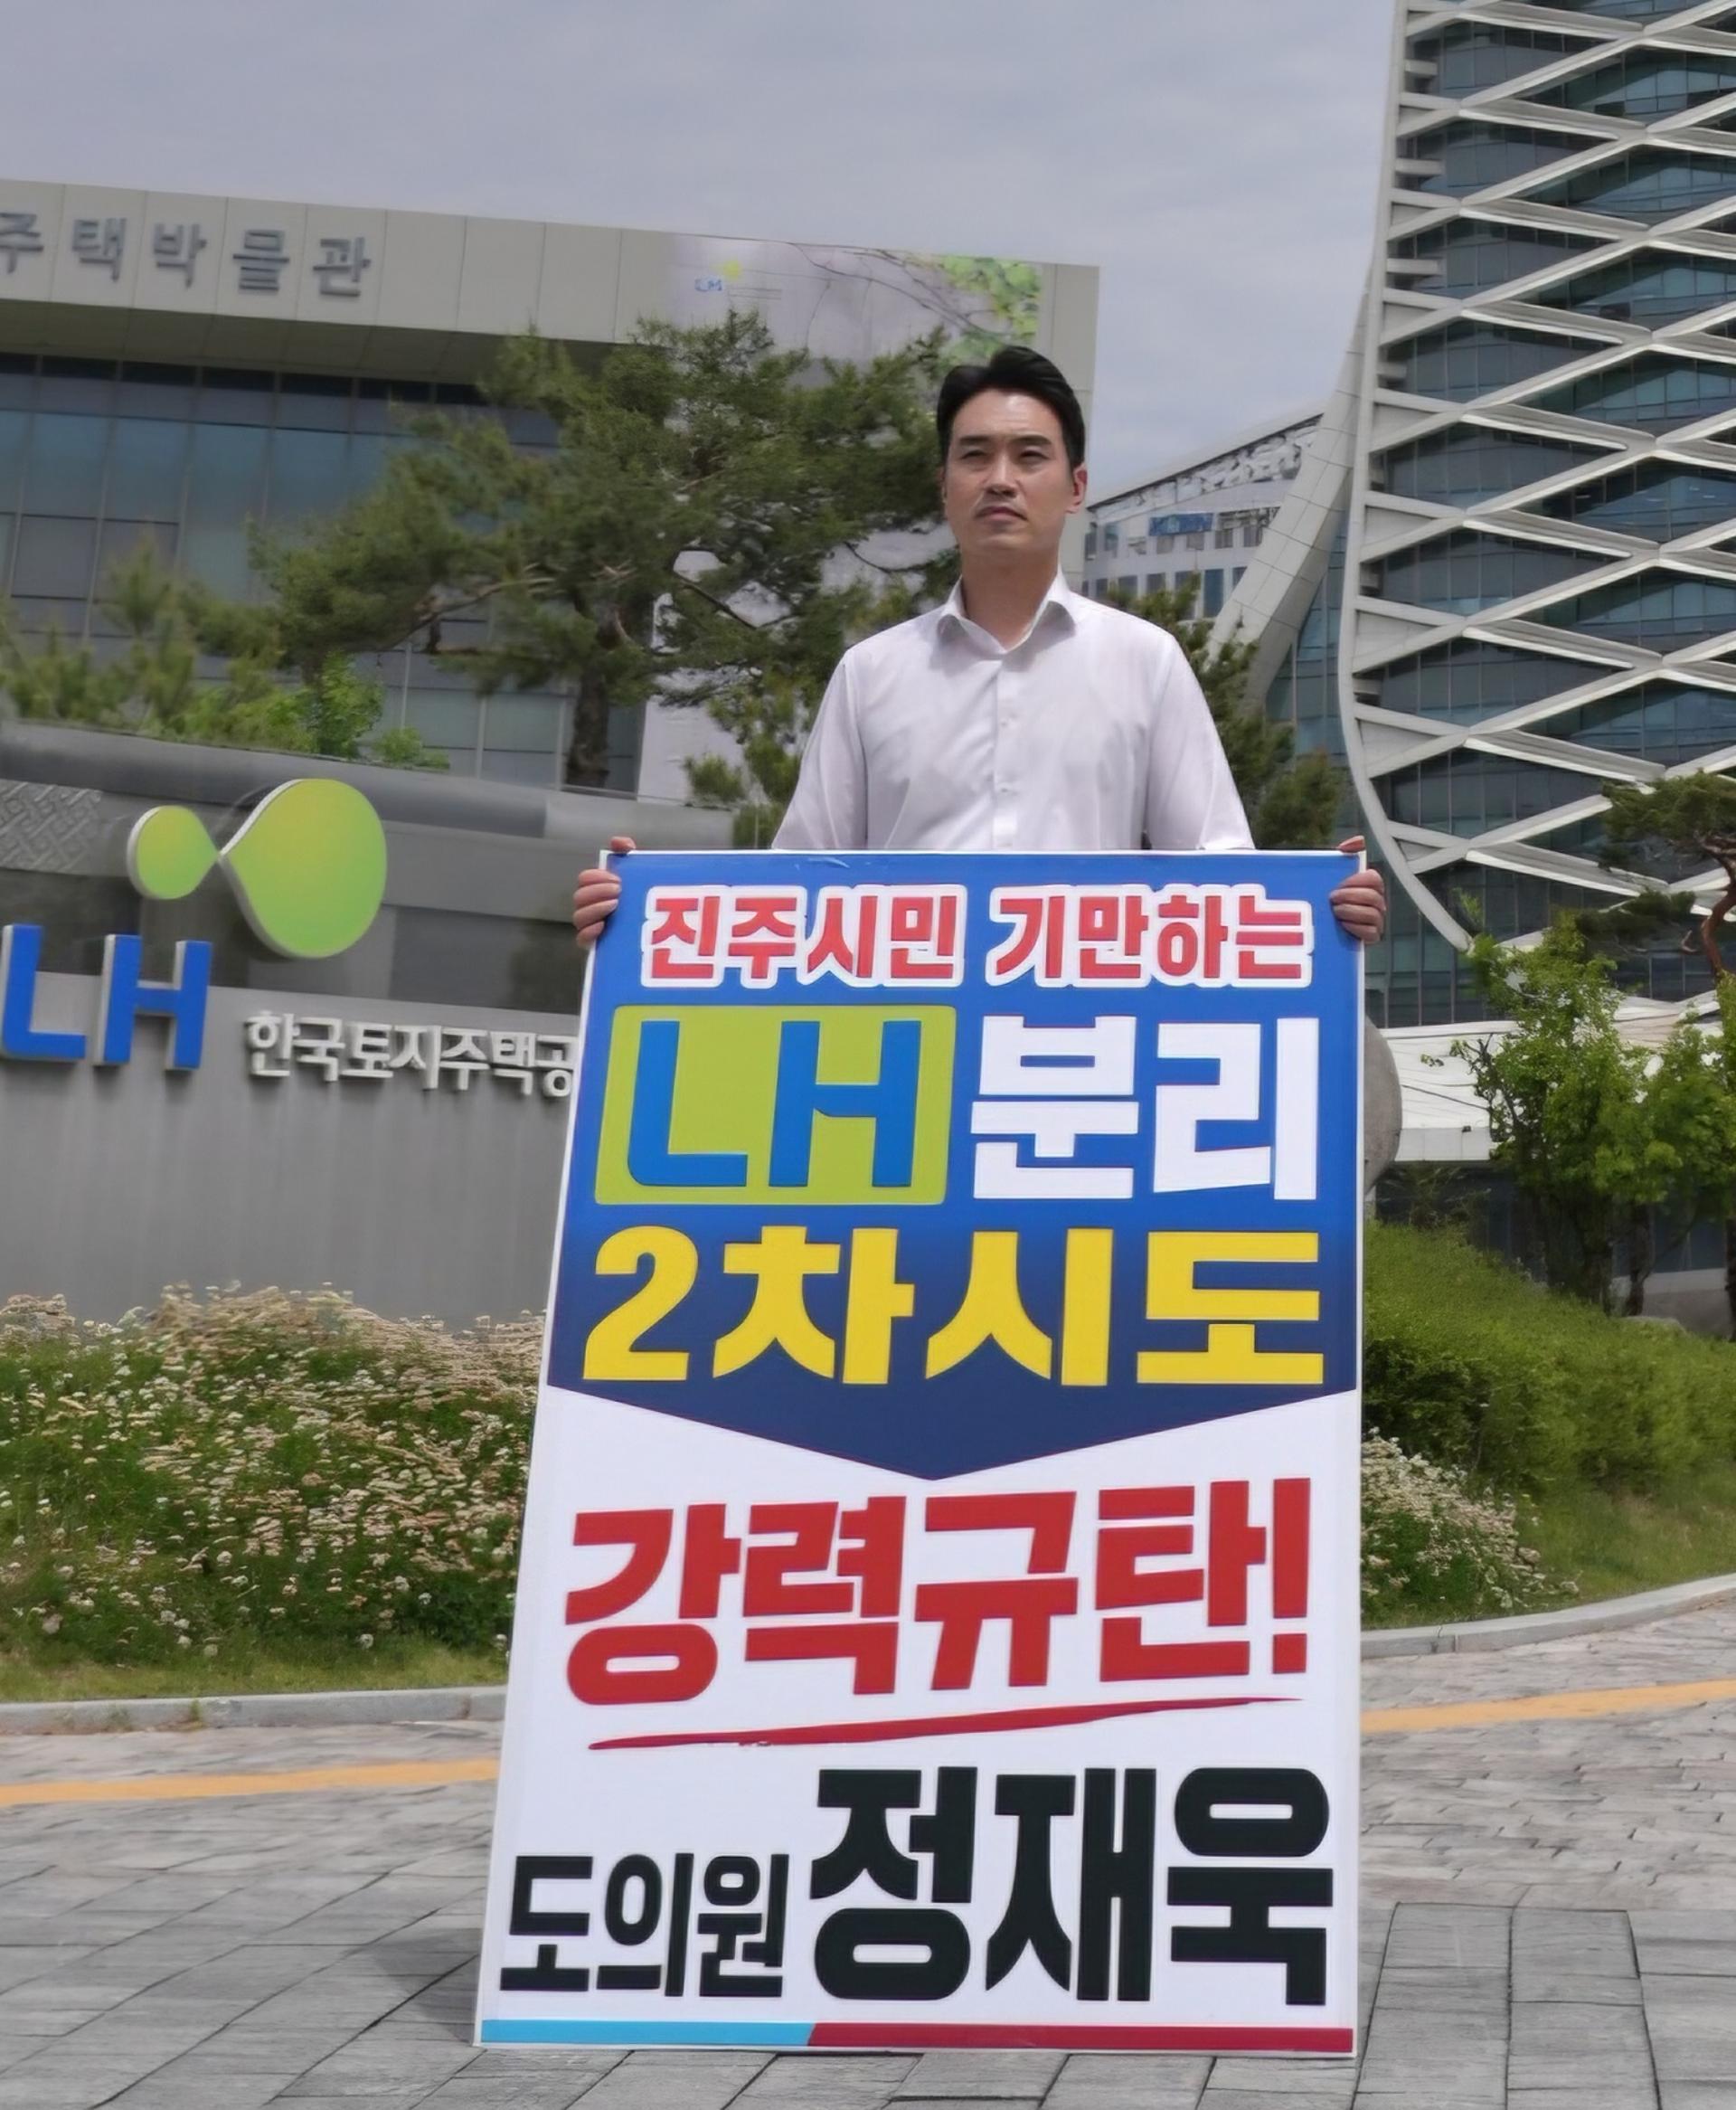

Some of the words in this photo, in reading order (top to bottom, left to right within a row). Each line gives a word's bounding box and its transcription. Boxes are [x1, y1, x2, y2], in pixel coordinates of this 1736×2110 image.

[0, 923, 212, 1071] LH
[646, 890, 962, 983] 진주시민
[990, 890, 1307, 983] 기만하는
[627, 1019, 921, 1187] LH
[971, 1015, 1319, 1200] 분리
[564, 1477, 1311, 1706] 강력규탄!
[499, 1852, 790, 1998] 도의원
[808, 1765, 1334, 2007] 정재욱
